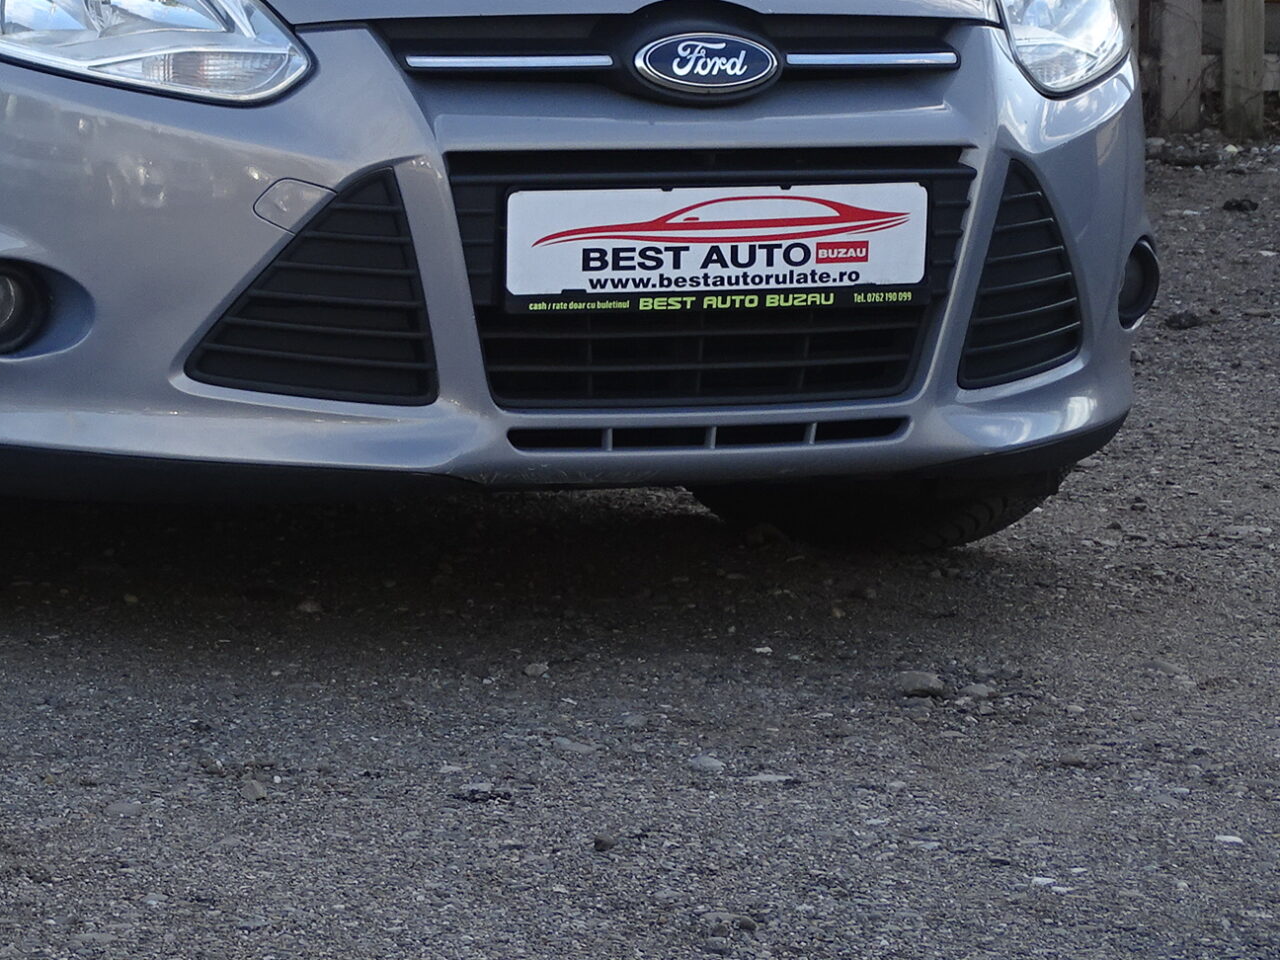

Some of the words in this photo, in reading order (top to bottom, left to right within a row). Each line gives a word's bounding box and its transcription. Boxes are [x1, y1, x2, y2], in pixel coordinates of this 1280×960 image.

[672, 41, 747, 76] Ford
[582, 246, 690, 271] BEST
[700, 243, 811, 270] AUTO
[818, 247, 867, 259] BUZAU
[589, 270, 860, 289] www.bestautorulate.ro
[639, 296, 696, 311] BEST
[703, 295, 759, 309] AUTO
[765, 293, 834, 308] BUZAU
[854, 292, 866, 303] Tel.
[867, 292, 884, 303] 0762
[885, 291, 897, 302] 190
[898, 291, 912, 302] 099
[528, 302, 547, 311] cash
